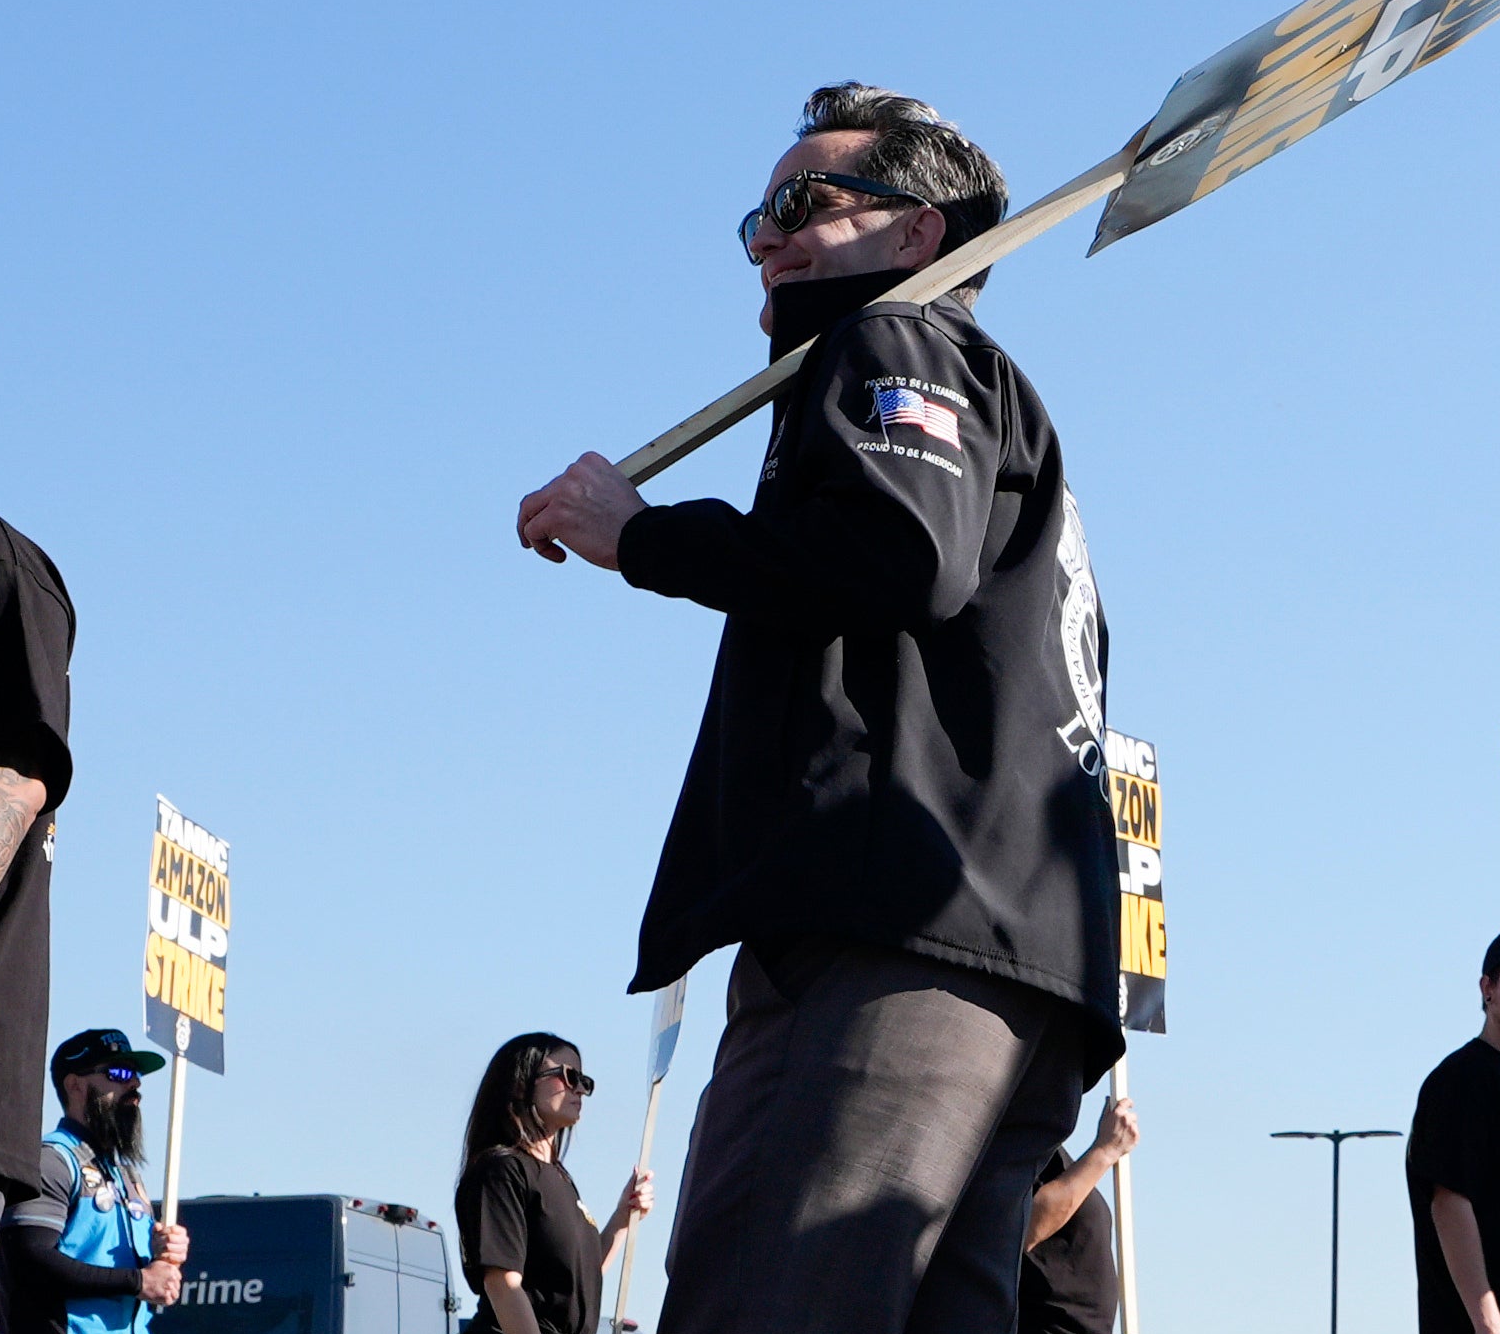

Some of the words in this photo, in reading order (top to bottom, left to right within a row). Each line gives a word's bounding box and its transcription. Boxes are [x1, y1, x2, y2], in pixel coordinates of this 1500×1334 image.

[864, 376, 893, 390] PROUD
[896, 376, 907, 386] TO
[909, 378, 922, 388] BE
[923, 381, 930, 391] A
[931, 383, 969, 409] TEAMSTER
[857, 442, 891, 453] PROUD
[893, 445, 904, 455] TO
[906, 447, 920, 459] BE
[921, 450, 963, 478] AMERICAN
[158, 804, 229, 875] TANNC
[1116, 776, 1157, 844] ZON
[156, 841, 226, 924] AMAZON
[150, 885, 228, 962] ULP
[1121, 892, 1167, 980] IKE
[145, 931, 226, 1033] STRIKE
[157, 1271, 264, 1314] rime
